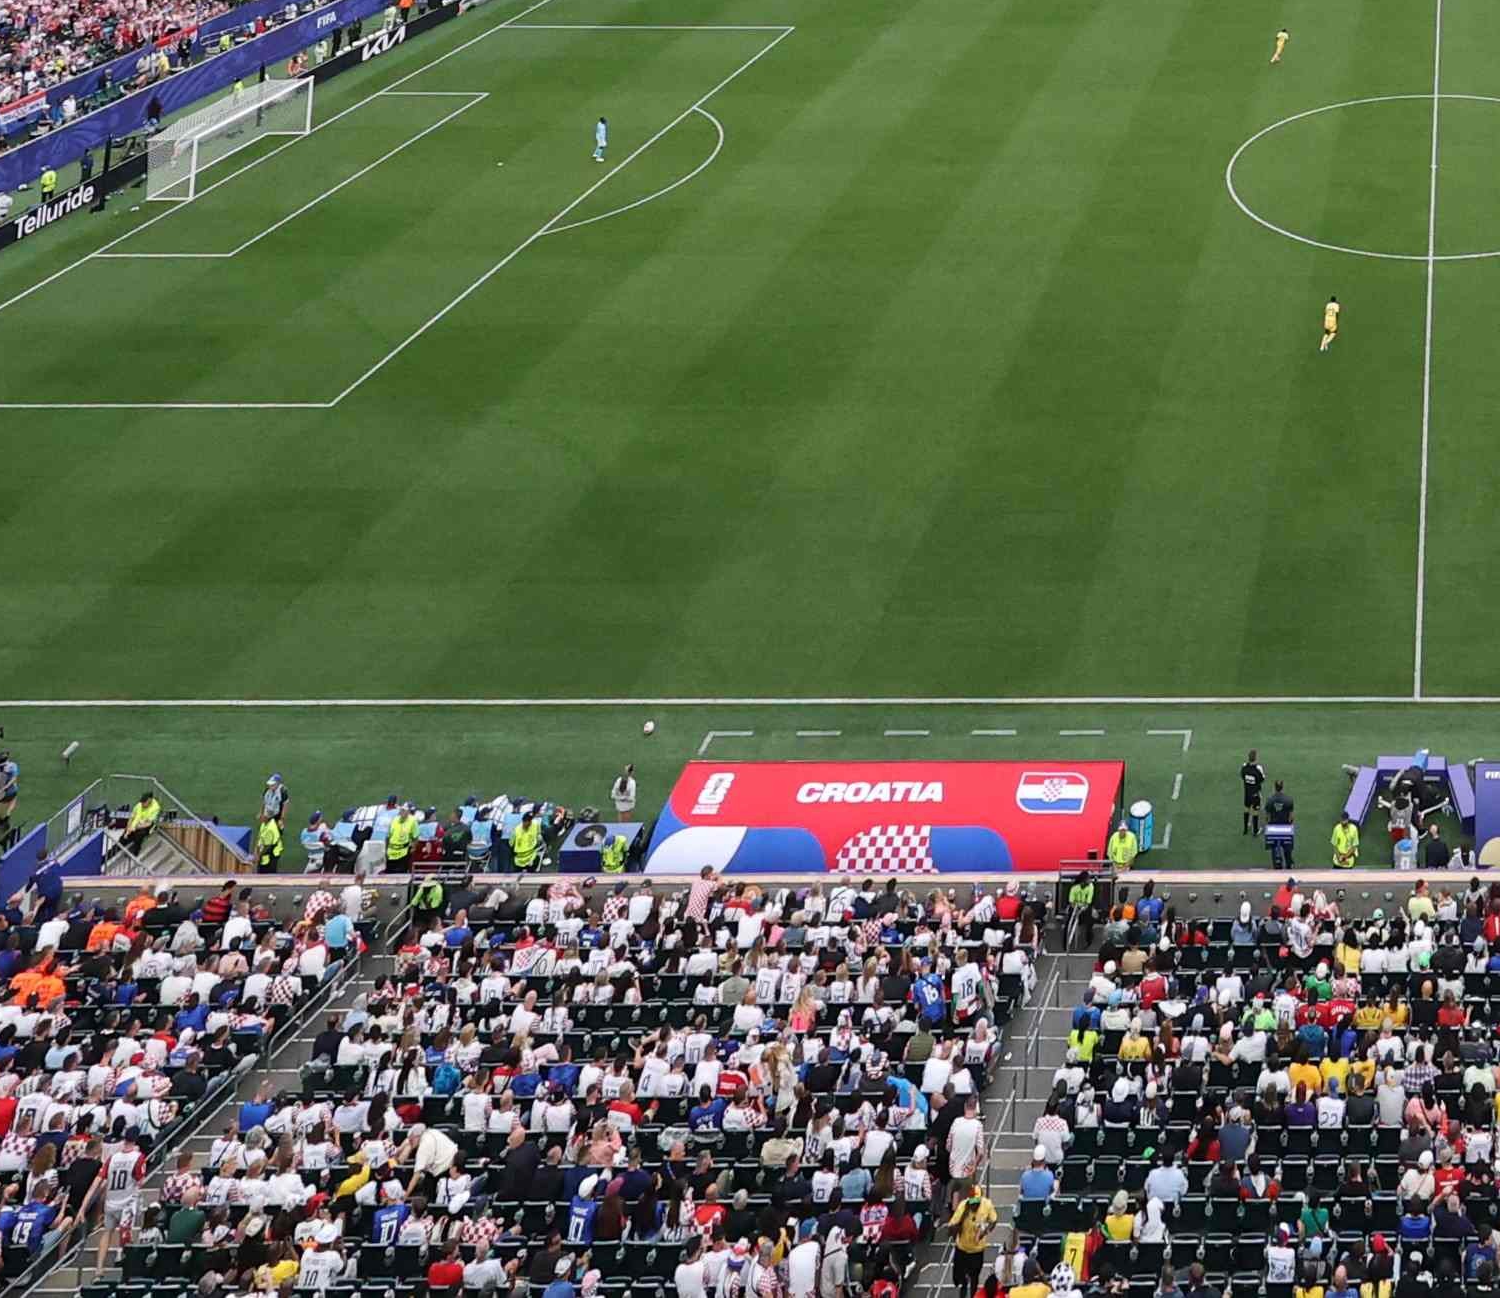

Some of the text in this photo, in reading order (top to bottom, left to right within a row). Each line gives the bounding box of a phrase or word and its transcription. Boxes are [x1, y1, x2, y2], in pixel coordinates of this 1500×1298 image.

[315, 11, 337, 29] FIFA
[14, 184, 95, 240] Telluride
[797, 781, 944, 803] CROATIA
[922, 984, 939, 1005] 16
[961, 977, 974, 999] 18
[110, 1169, 128, 1190] 10
[567, 1215, 585, 1242] 10
